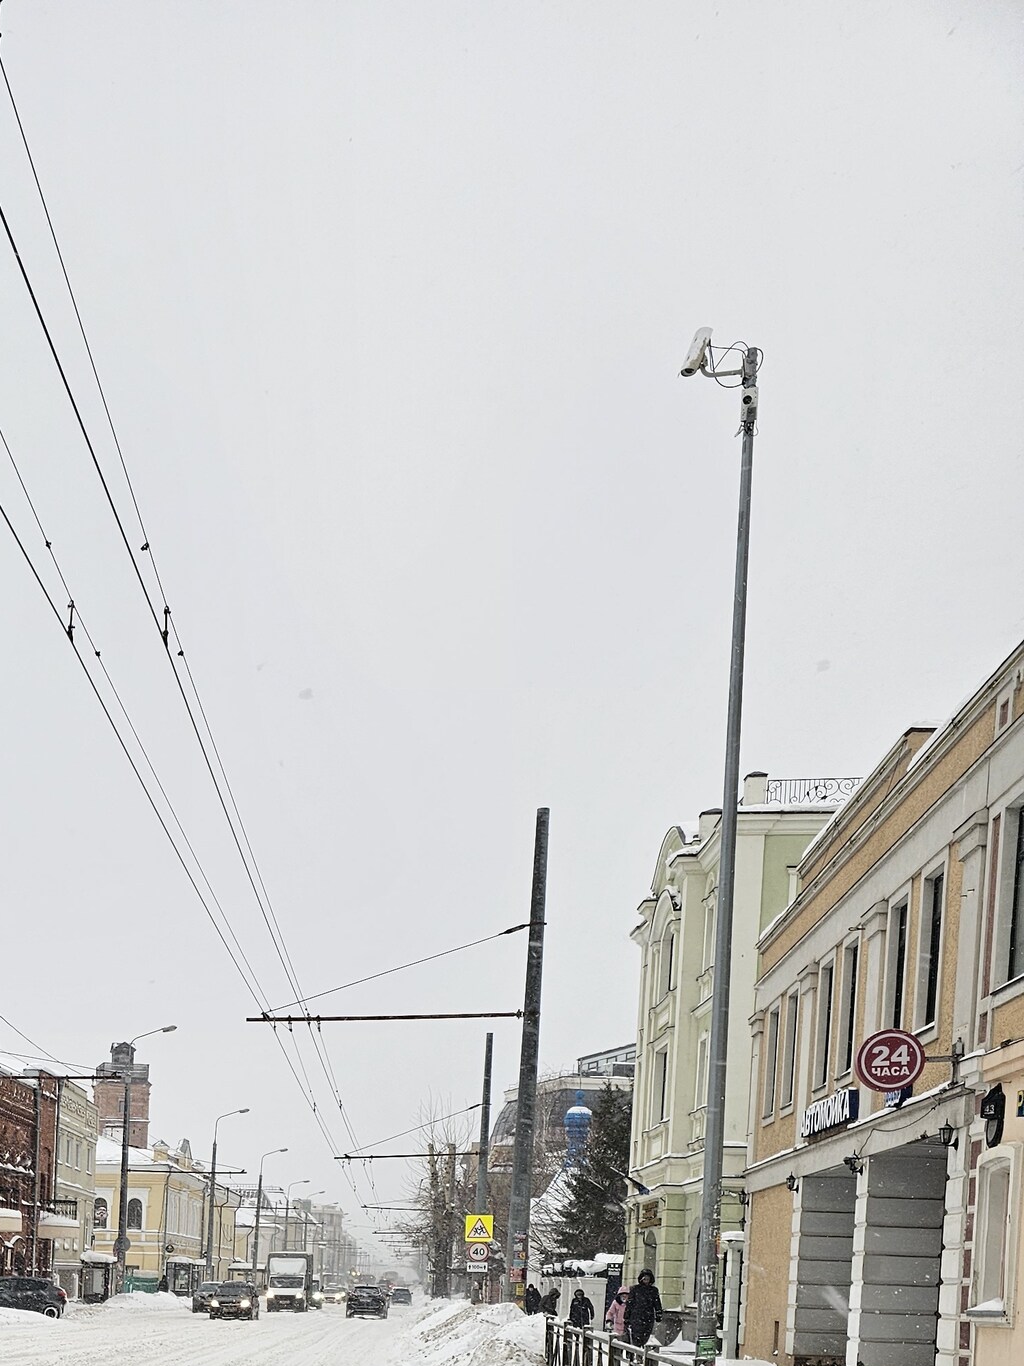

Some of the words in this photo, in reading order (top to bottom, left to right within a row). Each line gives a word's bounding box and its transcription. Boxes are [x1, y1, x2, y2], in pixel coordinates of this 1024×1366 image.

[871, 1044, 910, 1066] 24
[871, 1066, 910, 1077] ЧАСА
[800, 1089, 850, 1138] АВТОМОЙКА
[472, 1248, 485, 1256] 40
